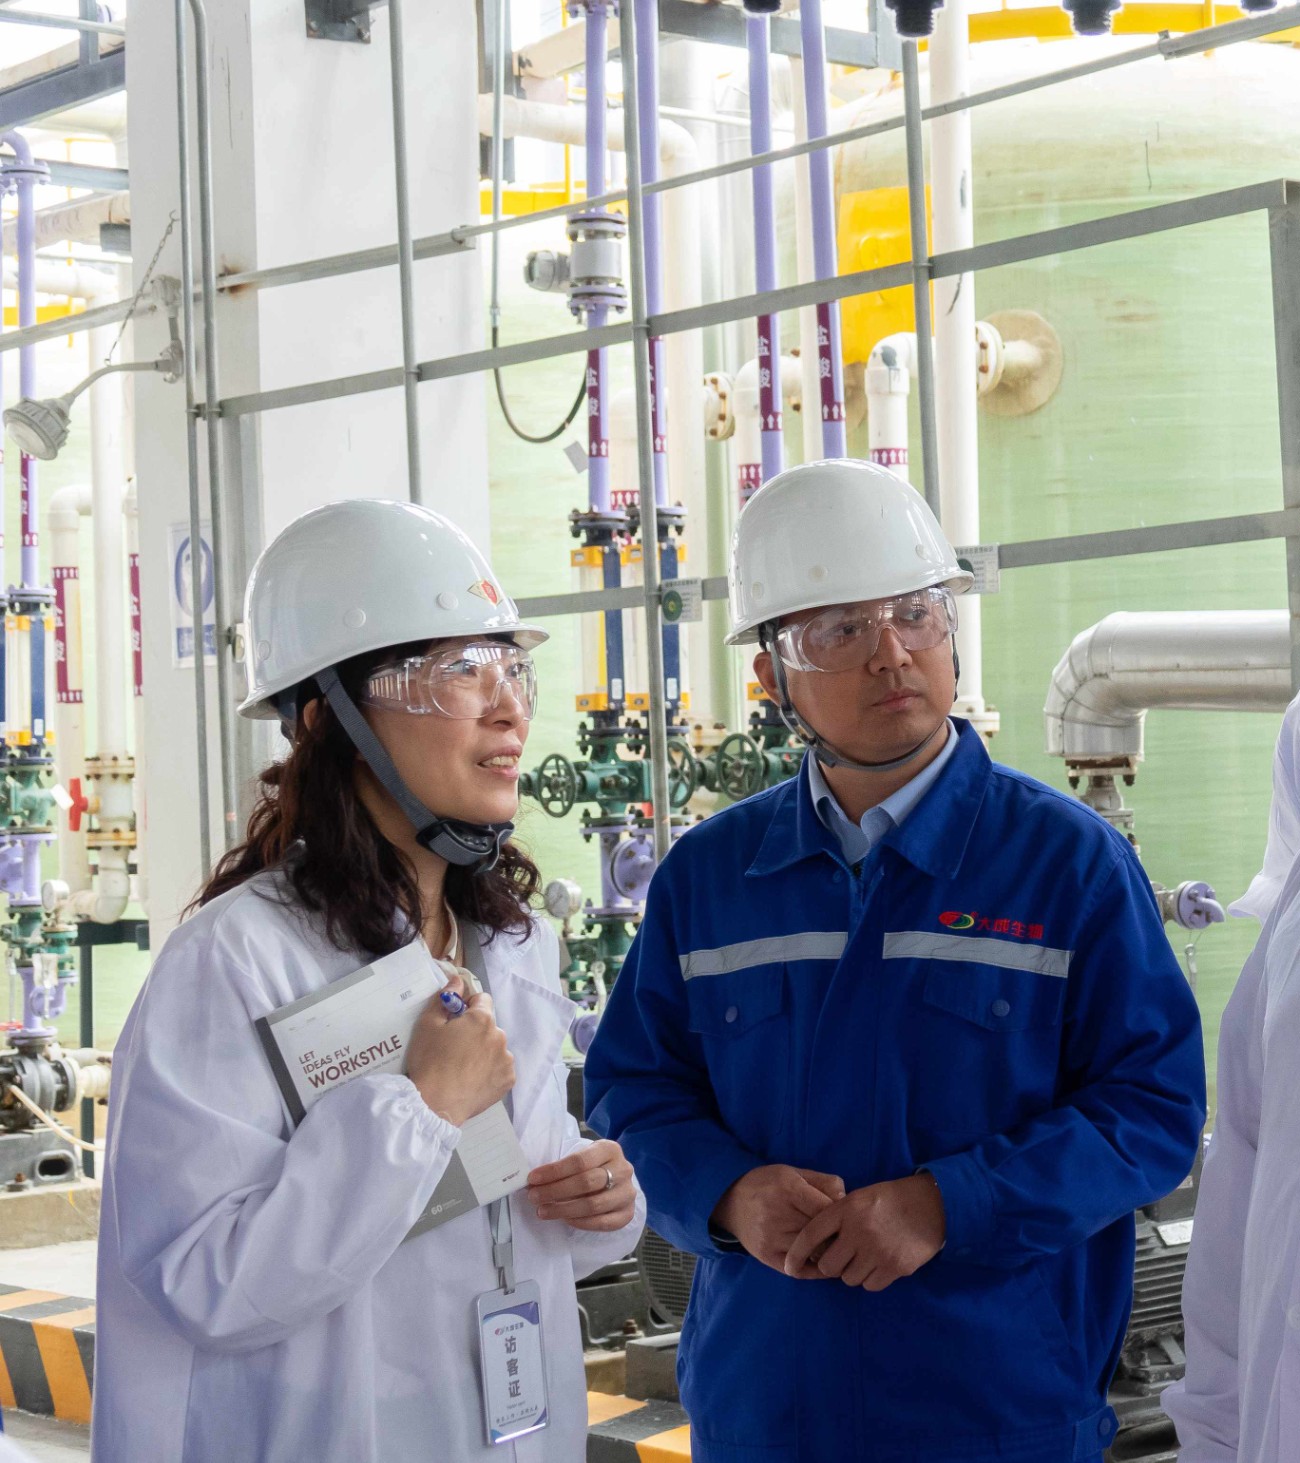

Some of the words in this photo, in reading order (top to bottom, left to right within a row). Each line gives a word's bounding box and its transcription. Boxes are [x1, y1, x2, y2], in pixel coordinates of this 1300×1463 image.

[298, 1050, 315, 1064] LET
[303, 1055, 333, 1074] IDEAS
[334, 1045, 351, 1060] FLY
[308, 1034, 402, 1088] WORKSTYLE
[431, 1204, 443, 1216] 60
[505, 1335, 521, 1398] 访客证
